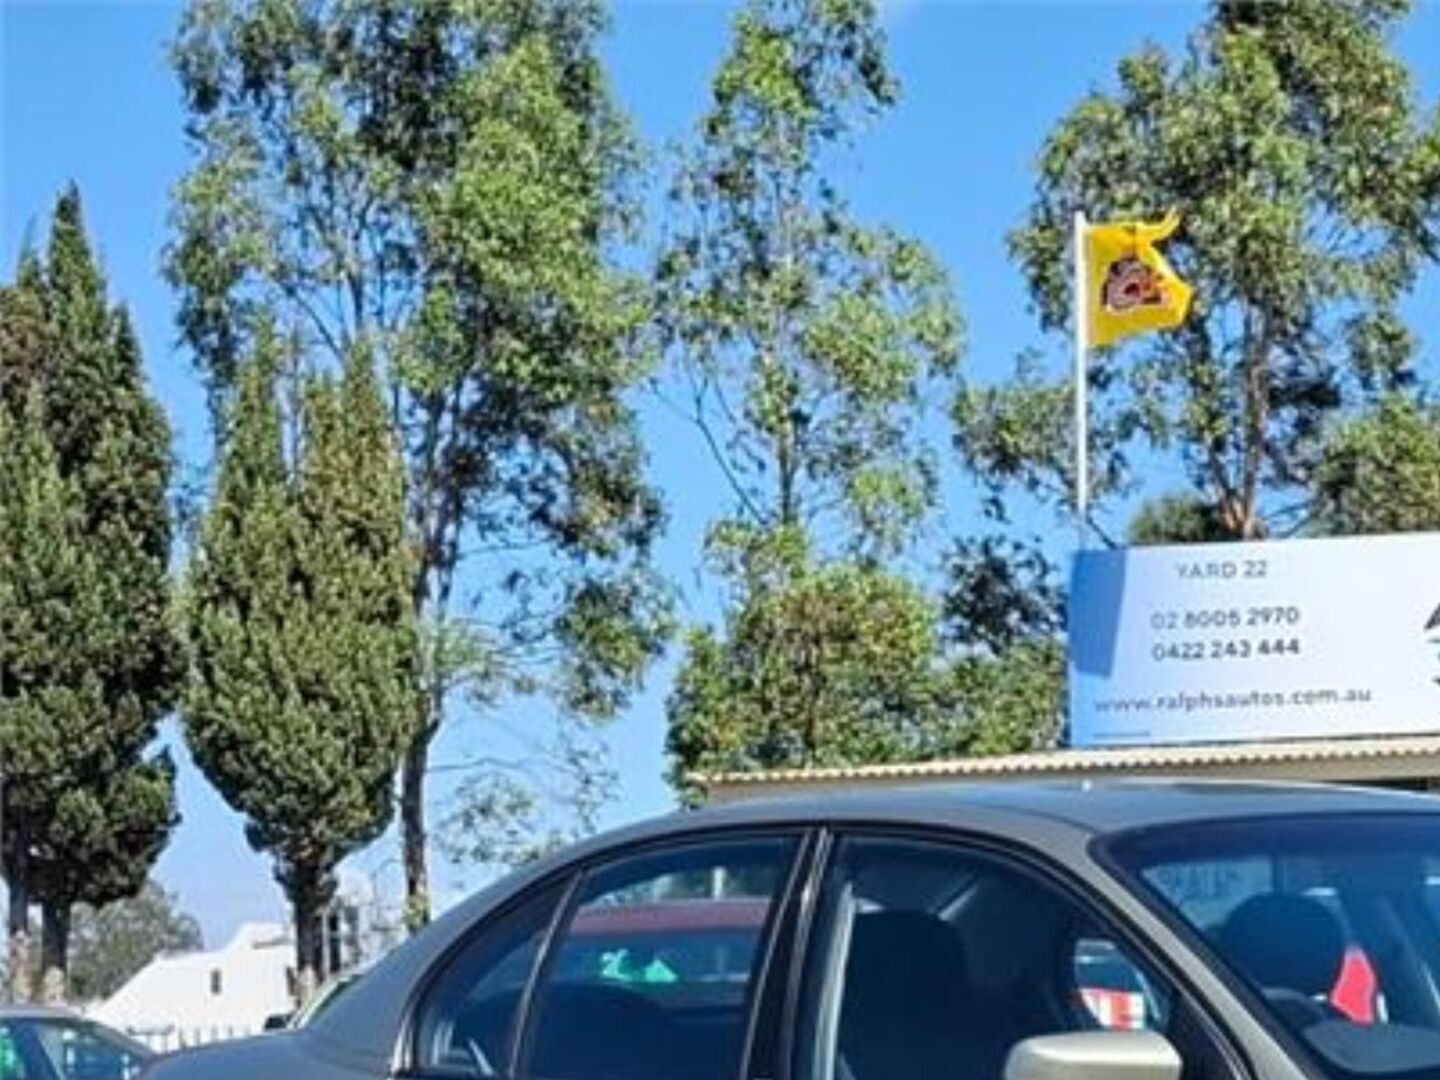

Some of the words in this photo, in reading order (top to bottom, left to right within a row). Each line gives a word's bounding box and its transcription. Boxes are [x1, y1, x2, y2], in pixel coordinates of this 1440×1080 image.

[1176, 561, 1237, 580] YARD
[1242, 559, 1268, 579] 22
[1151, 611, 1178, 630] 02
[1246, 606, 1301, 627] 2970
[1152, 643, 1206, 662] 0422
[1210, 640, 1252, 659] 243
[1257, 637, 1301, 656] 444
